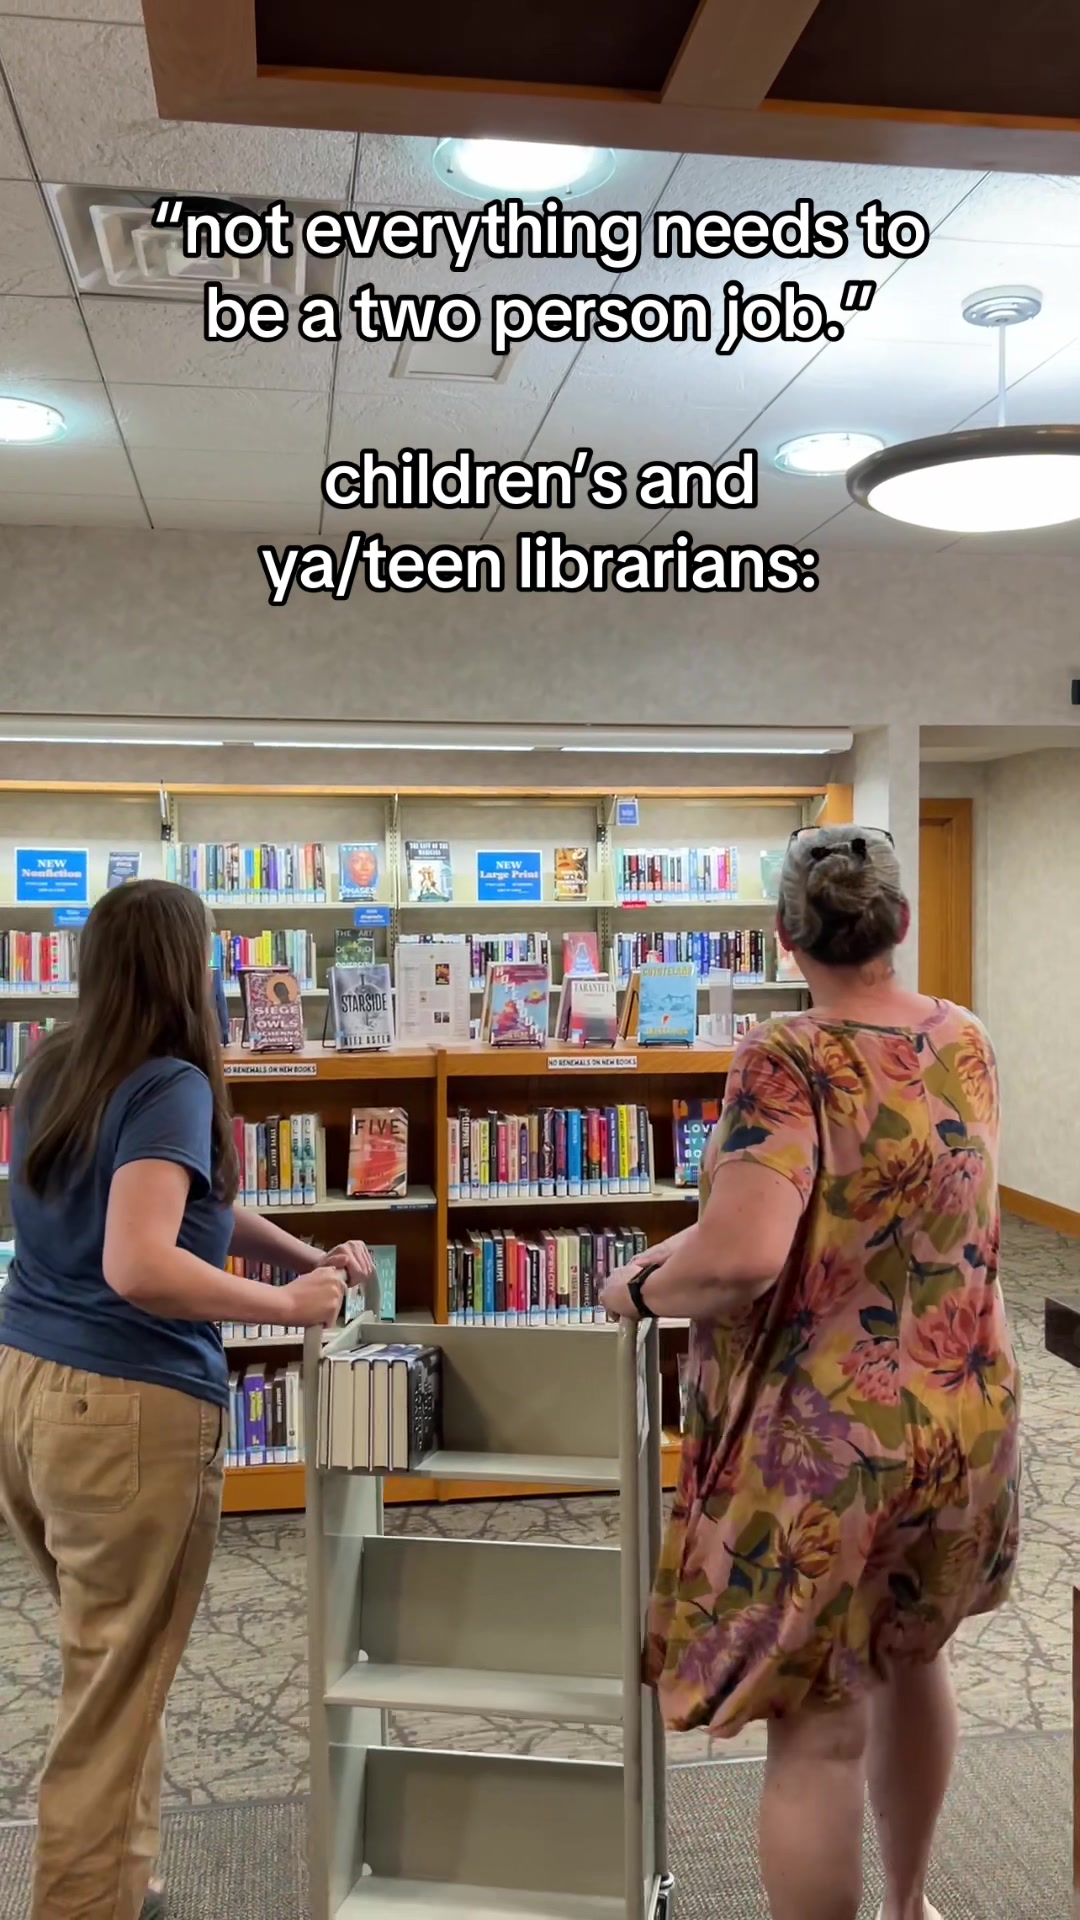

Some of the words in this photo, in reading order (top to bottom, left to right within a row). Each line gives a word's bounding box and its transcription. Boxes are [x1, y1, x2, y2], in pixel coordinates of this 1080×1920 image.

[37, 859, 67, 868] NEW
[496, 861, 523, 869] NEW
[21, 868, 82, 878] Nonfiction
[479, 870, 509, 880] Large
[511, 870, 539, 879] Print
[341, 993, 388, 1013] STARSIDE
[254, 1006, 298, 1015] SIEGE
[256, 1019, 298, 1028] OWLS
[366, 1034, 391, 1045] ASTER
[592, 1058, 601, 1066] ON
[602, 1058, 615, 1066] NEW
[616, 1058, 636, 1066] BOOKS
[294, 1065, 315, 1073] BOOKS
[355, 1118, 401, 1136] FIVE
[685, 1137, 698, 1145] BY
[684, 1149, 704, 1159] BO
[547, 1273, 555, 1292] CITY
